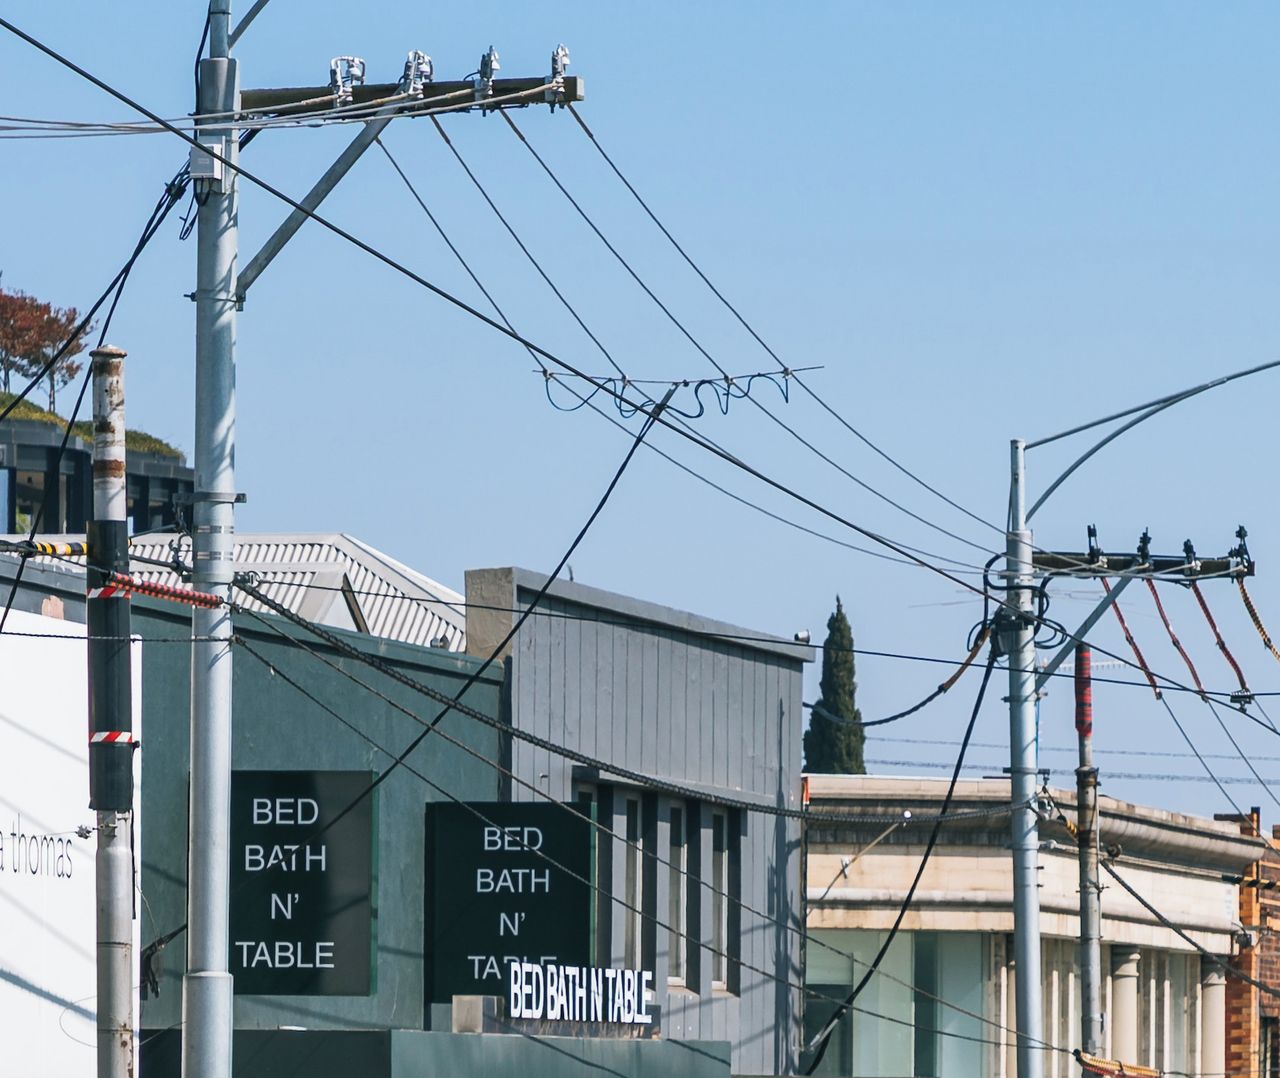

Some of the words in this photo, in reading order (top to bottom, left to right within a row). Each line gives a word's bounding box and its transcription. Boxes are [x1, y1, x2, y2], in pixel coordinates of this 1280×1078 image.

[252, 798, 319, 825] BED
[10, 815, 73, 879] thomas
[483, 826, 543, 852] BED
[245, 844, 326, 872] BATH
[476, 868, 550, 893] BATH
[235, 941, 335, 969] TABLE
[510, 962, 544, 1019] BED
[546, 964, 587, 1022] BATH
[590, 967, 603, 1023] N
[605, 968, 653, 1024] TABLE
